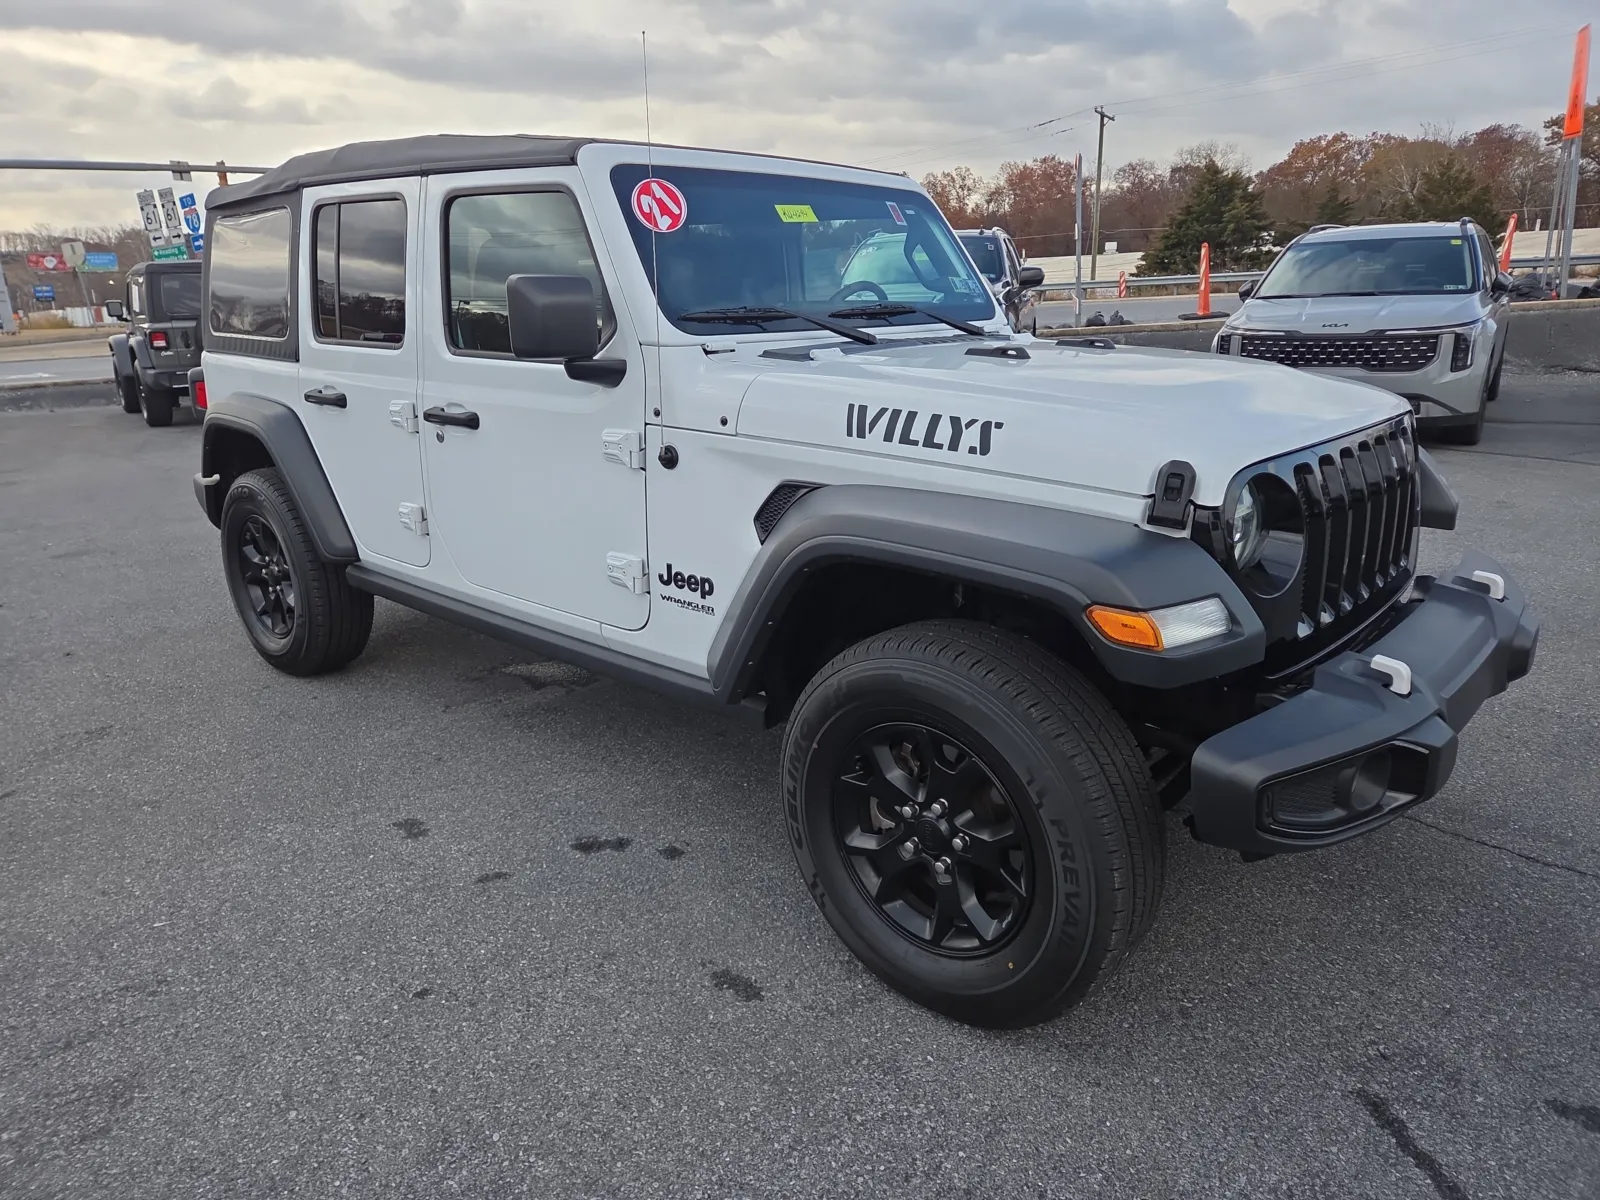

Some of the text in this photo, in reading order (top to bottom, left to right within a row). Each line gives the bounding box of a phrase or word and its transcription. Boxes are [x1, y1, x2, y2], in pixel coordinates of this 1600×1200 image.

[182, 197, 192, 206] TO
[640, 182, 681, 231] 21
[146, 210, 158, 225] 61
[166, 207, 176, 221] 61
[186, 214, 200, 230] 78
[846, 403, 1005, 456] WILLYS
[658, 562, 715, 600] Jeep
[660, 593, 715, 613] WRANGLER
